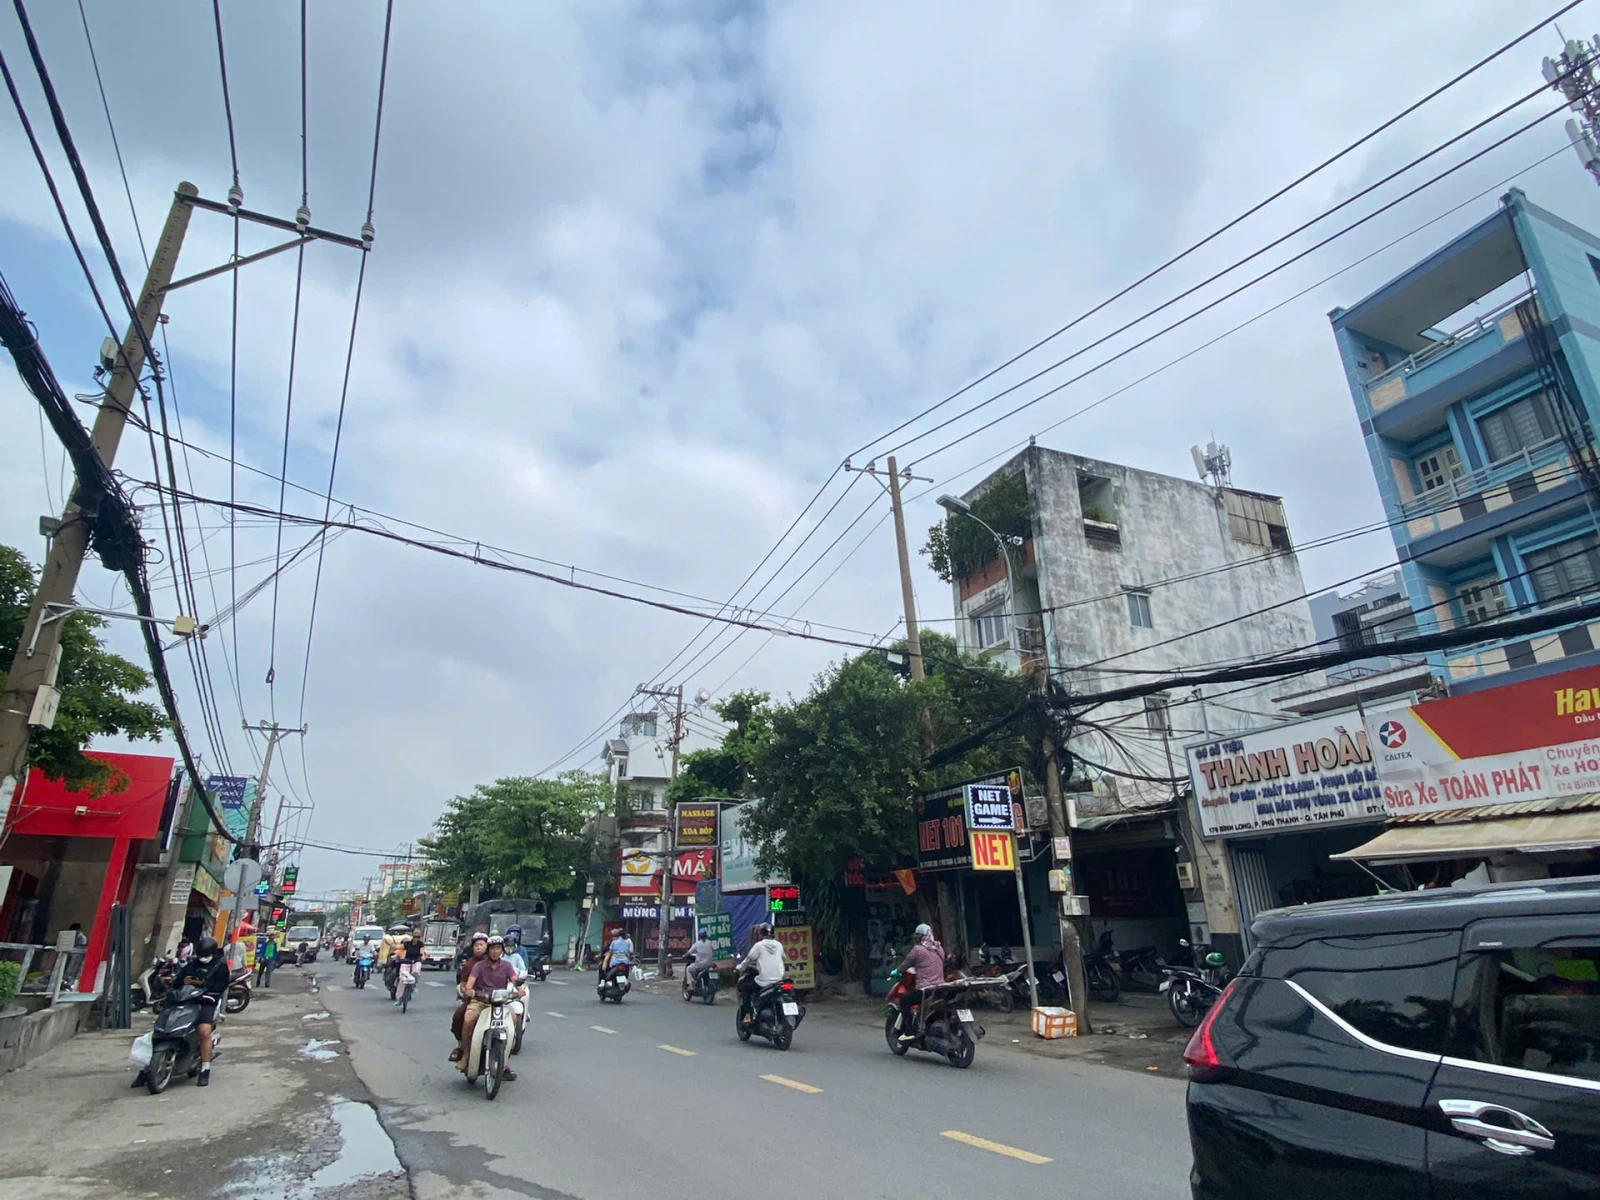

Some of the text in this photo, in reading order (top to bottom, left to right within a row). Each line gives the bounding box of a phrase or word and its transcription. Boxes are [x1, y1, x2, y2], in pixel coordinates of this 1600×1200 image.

[1384, 751, 1412, 762] CALTEX
[1199, 747, 1290, 790] THANH
[1552, 757, 1600, 777] Xe HO
[1384, 761, 1542, 809] Sửa Xe TOÀN PHÁT
[978, 790, 1001, 802] NET
[681, 809, 715, 817] MASSAGE
[974, 803, 1009, 816] GAME
[1313, 811, 1328, 820] TÂN
[1330, 809, 1345, 818] PHÚ
[682, 827, 697, 835] XOA
[919, 818, 941, 852] NET
[942, 814, 965, 848] 101
[973, 833, 1009, 866] NET
[623, 906, 657, 917] MỪNG
